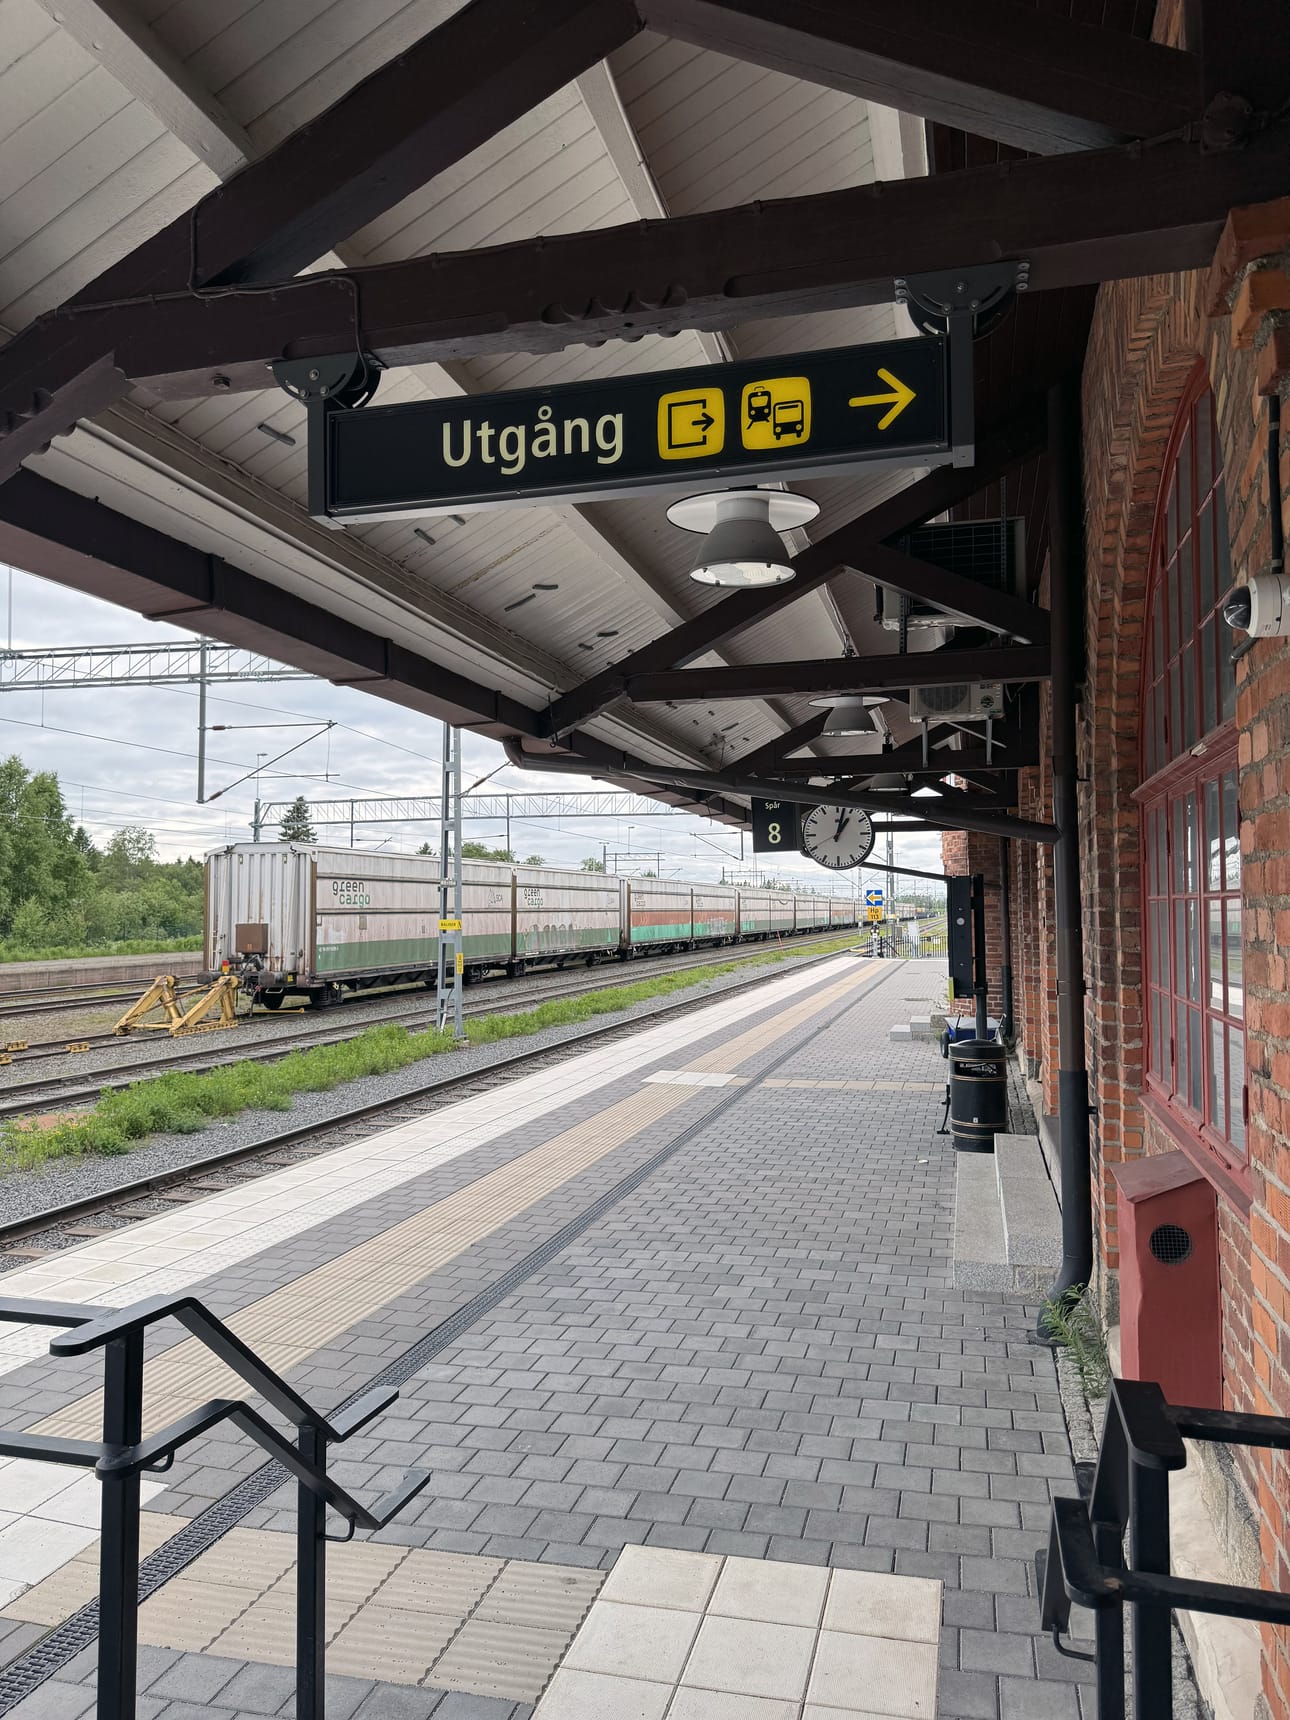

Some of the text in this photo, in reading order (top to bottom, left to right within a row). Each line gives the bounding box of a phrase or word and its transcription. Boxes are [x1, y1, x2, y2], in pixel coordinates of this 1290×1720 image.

[442, 405, 624, 475] Utgång
[765, 801, 780, 810] Spår
[768, 822, 781, 844] 8
[332, 881, 365, 896] green
[523, 888, 541, 899] green
[339, 894, 371, 909] cargo
[527, 897, 544, 909] cargo
